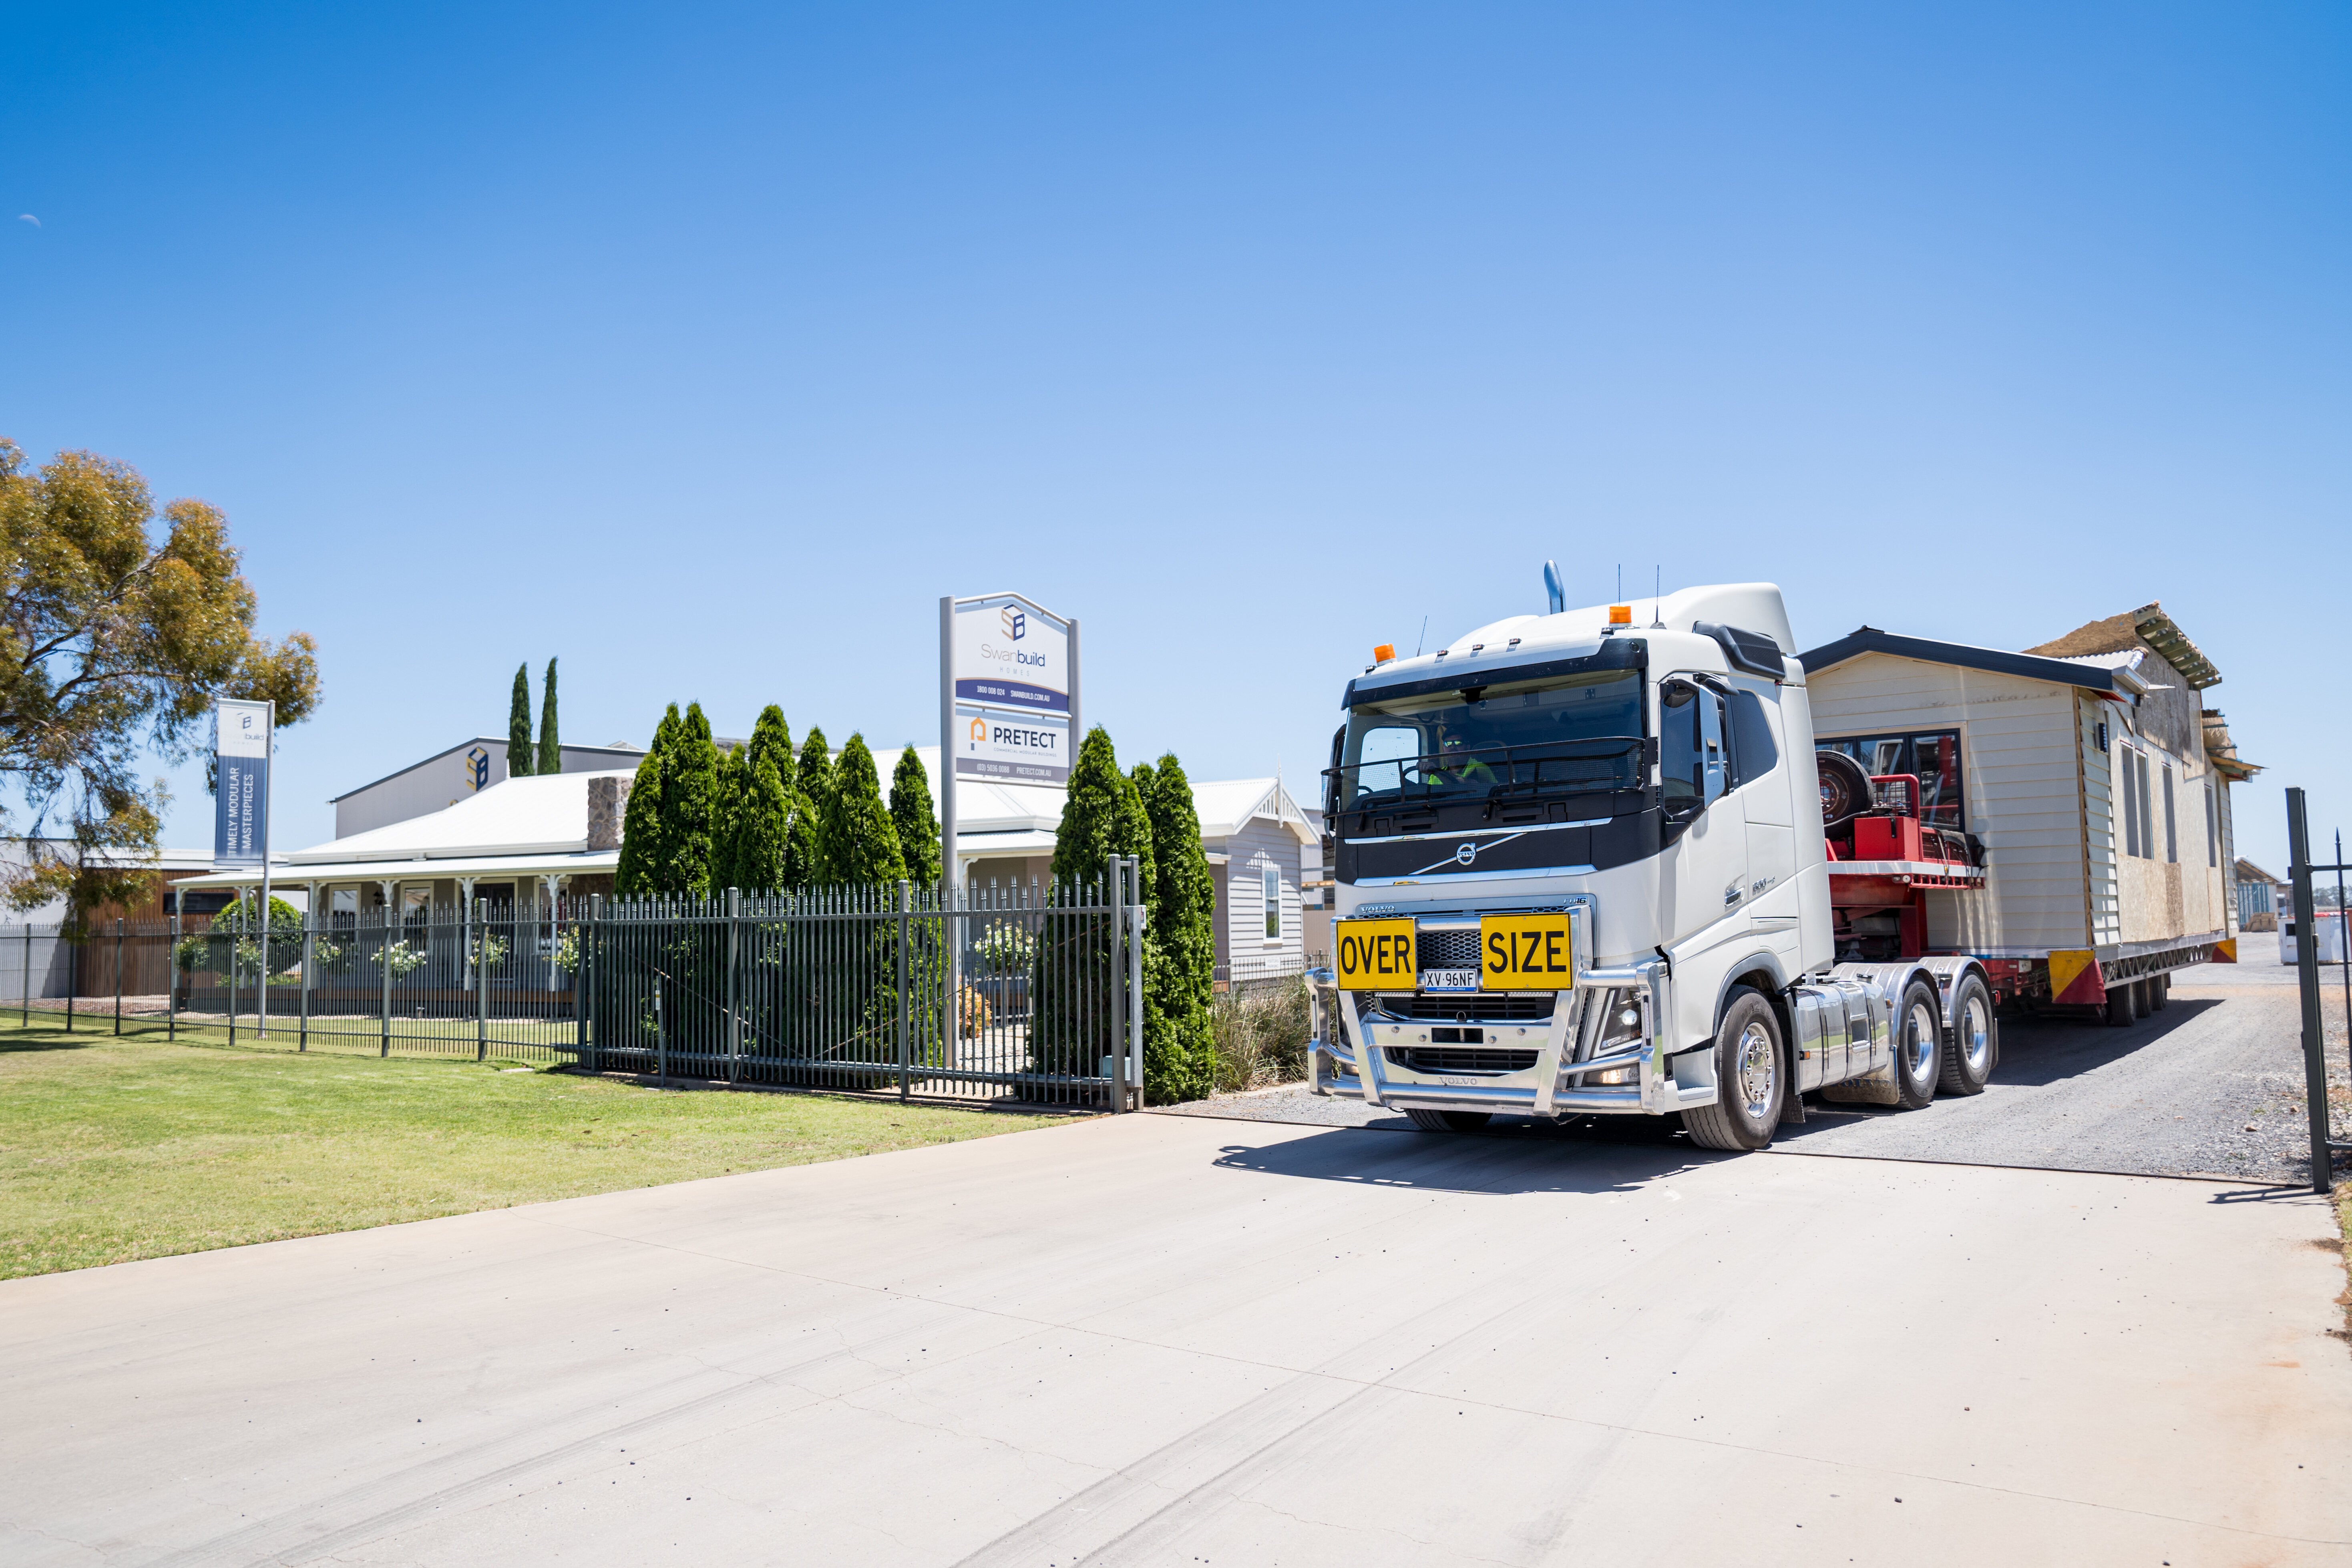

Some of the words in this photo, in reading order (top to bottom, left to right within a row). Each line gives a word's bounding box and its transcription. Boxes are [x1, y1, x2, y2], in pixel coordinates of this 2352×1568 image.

[981, 644, 1045, 667] Swanbuild
[1000, 667, 1030, 676] HOMES
[1011, 690, 1050, 702] SWANBUILD.COM.AU
[994, 727, 1056, 748] PRETECT
[977, 763, 986, 772] (03)
[987, 764, 998, 772] 5036
[999, 765, 1009, 773] 0088
[1016, 767, 1051, 777] PRETECT.COM.AU
[229, 767, 239, 817] MODULAR
[242, 774, 253, 848] MASTERPIECES
[228, 820, 238, 854] TIMELY
[1341, 935, 1411, 974] OVER
[1488, 931, 1566, 973] SIZE
[1439, 1077, 1478, 1085] VOLVO
